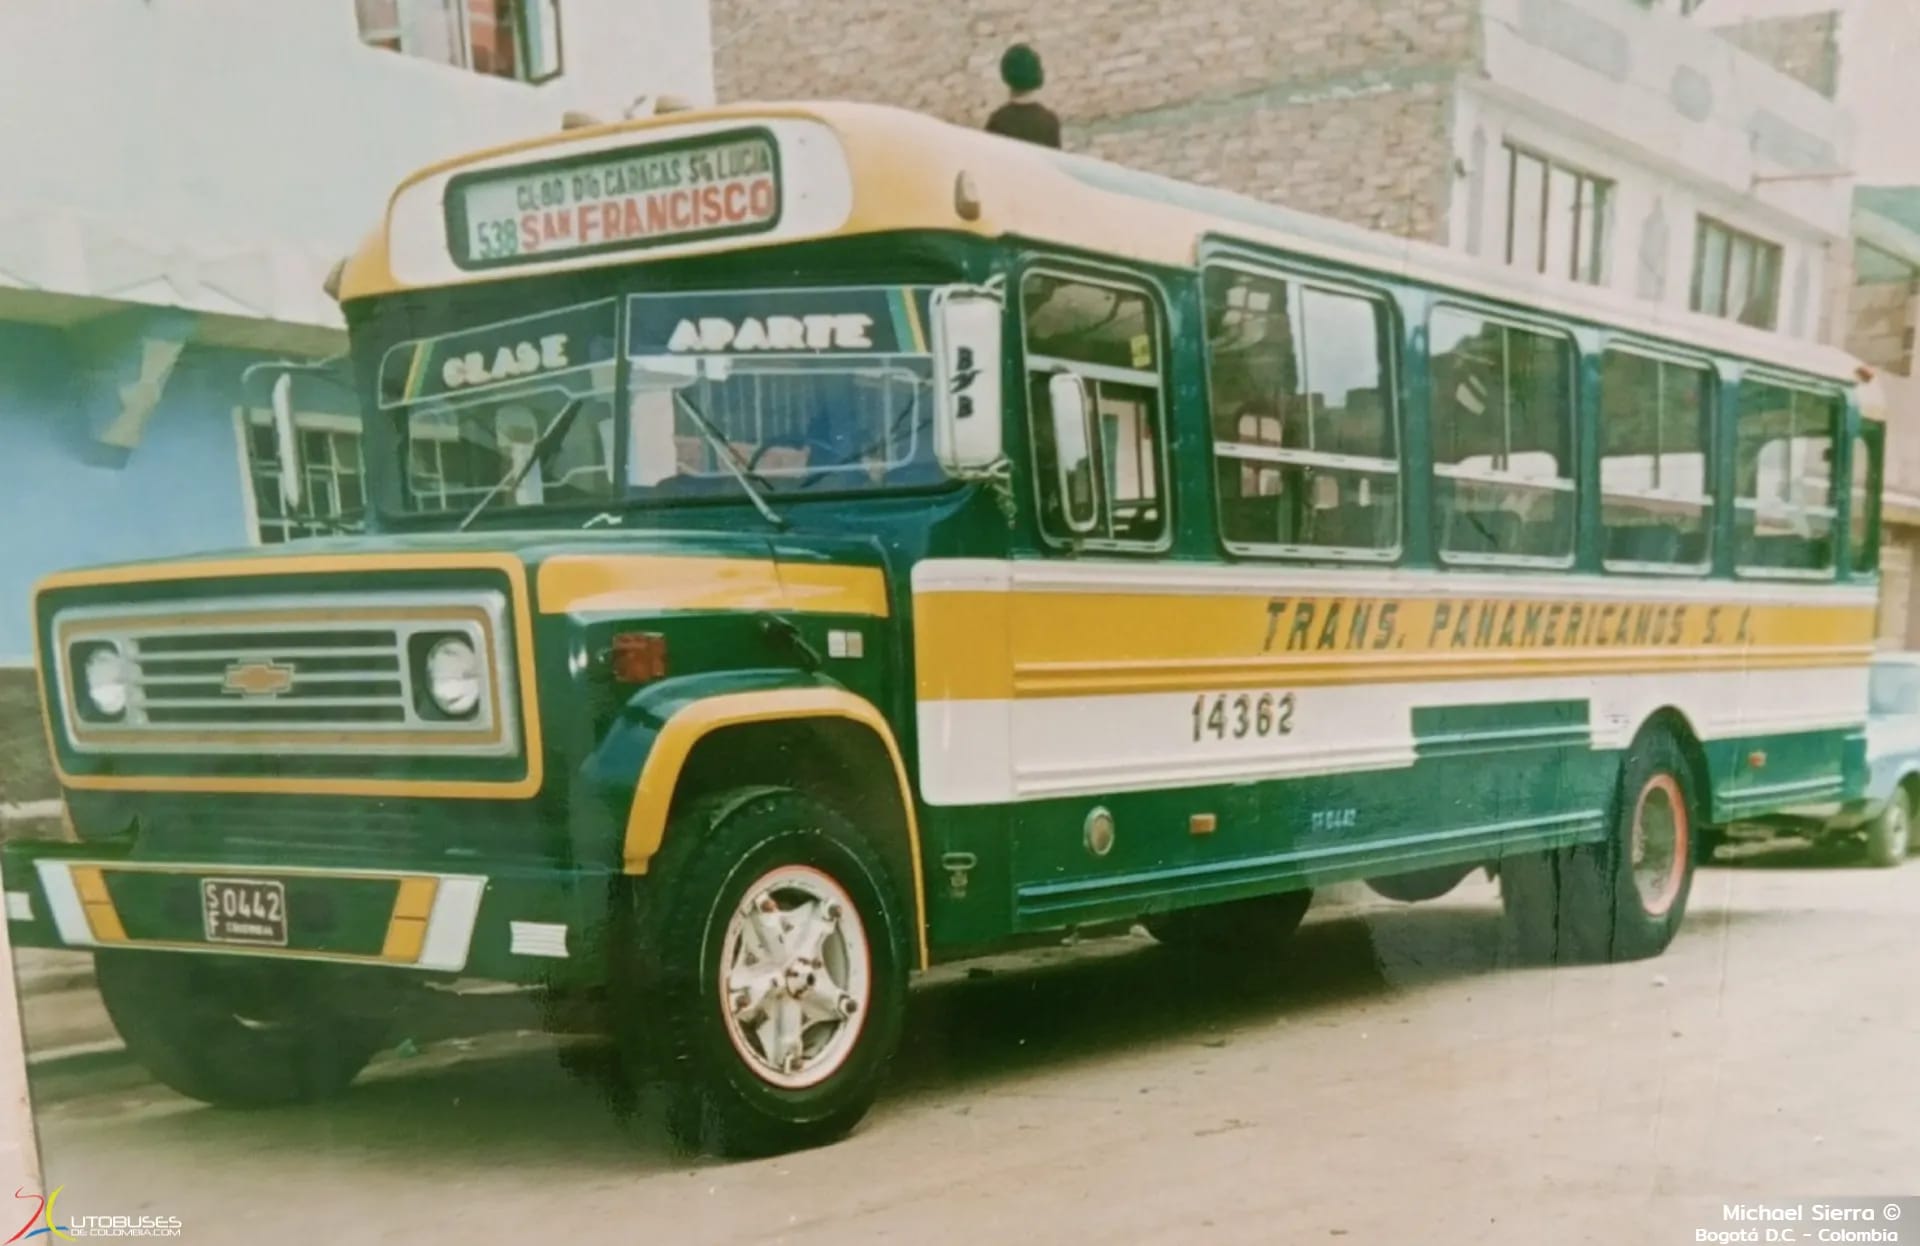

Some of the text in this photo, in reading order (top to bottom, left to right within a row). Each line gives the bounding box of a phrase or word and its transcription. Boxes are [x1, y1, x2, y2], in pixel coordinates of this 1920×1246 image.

[604, 158, 681, 197] CARACAS
[717, 147, 771, 181] LUCIA
[520, 178, 774, 251] SAN FRANCISCO
[667, 314, 873, 351] APARTE
[443, 333, 568, 388] CLASE
[1264, 599, 1406, 651] TRANS.
[1428, 600, 1686, 648] PANAMERICANOS
[1192, 693, 1296, 742] 14362
[223, 887, 282, 923] 0442
